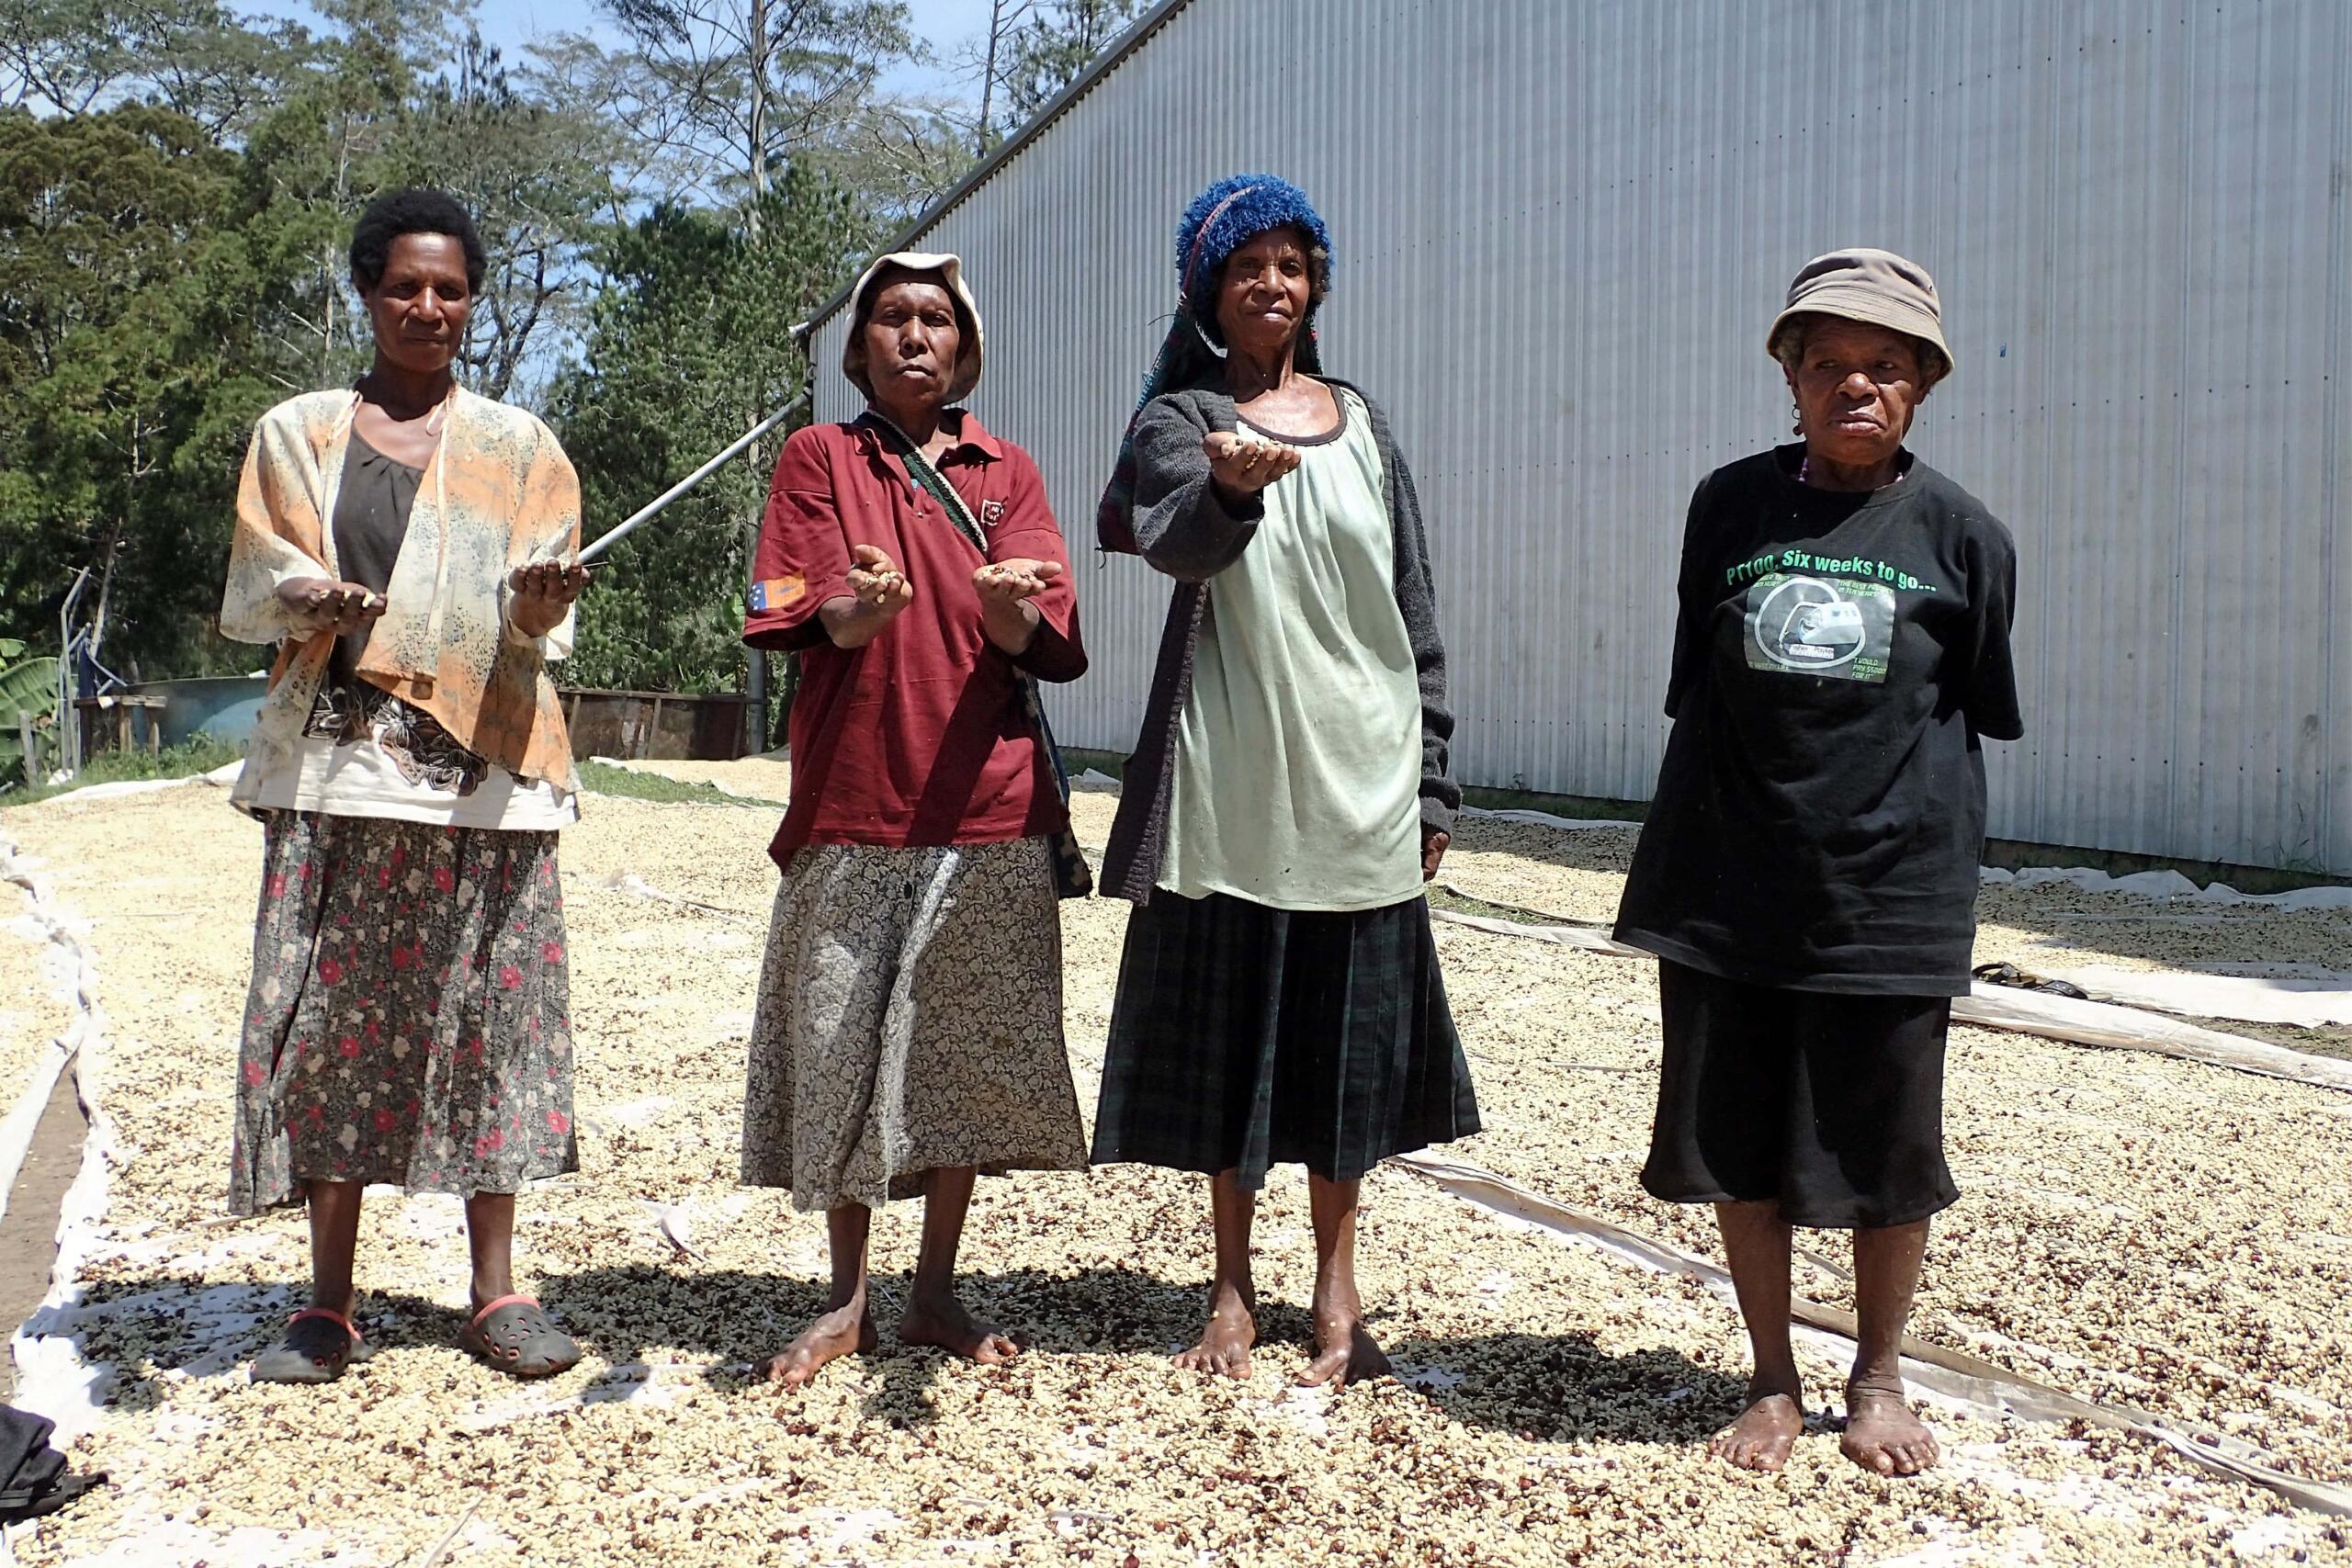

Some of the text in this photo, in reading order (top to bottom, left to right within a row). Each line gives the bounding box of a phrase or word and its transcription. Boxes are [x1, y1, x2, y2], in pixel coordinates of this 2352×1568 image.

[1781, 549, 1812, 569] Six
[1815, 556, 1873, 576] weeks
[1877, 560, 1894, 581] to
[1897, 571, 1937, 591] go...
